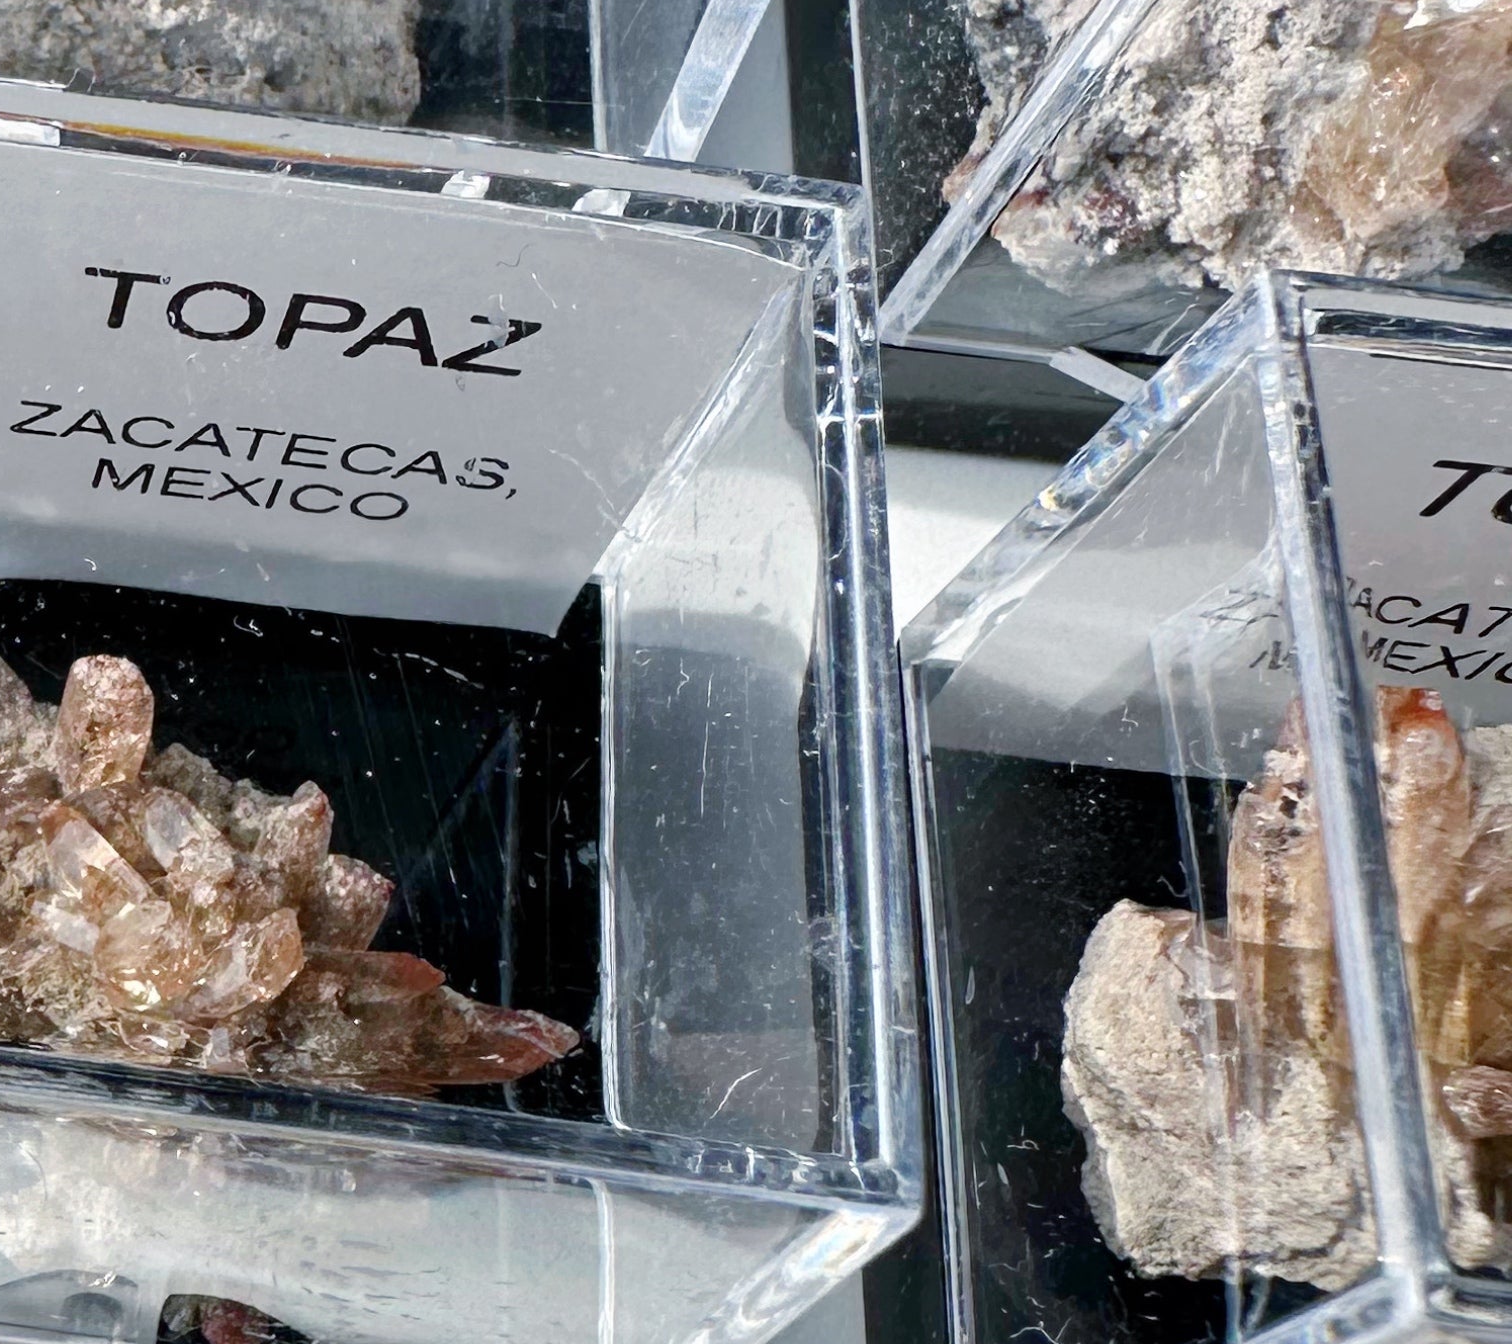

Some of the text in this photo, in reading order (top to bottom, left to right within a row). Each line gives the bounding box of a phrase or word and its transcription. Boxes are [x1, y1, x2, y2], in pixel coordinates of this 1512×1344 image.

[84, 266, 543, 377] TOPAZ
[9, 399, 518, 500] ZACATECAS,
[92, 457, 409, 522] MEXICO
